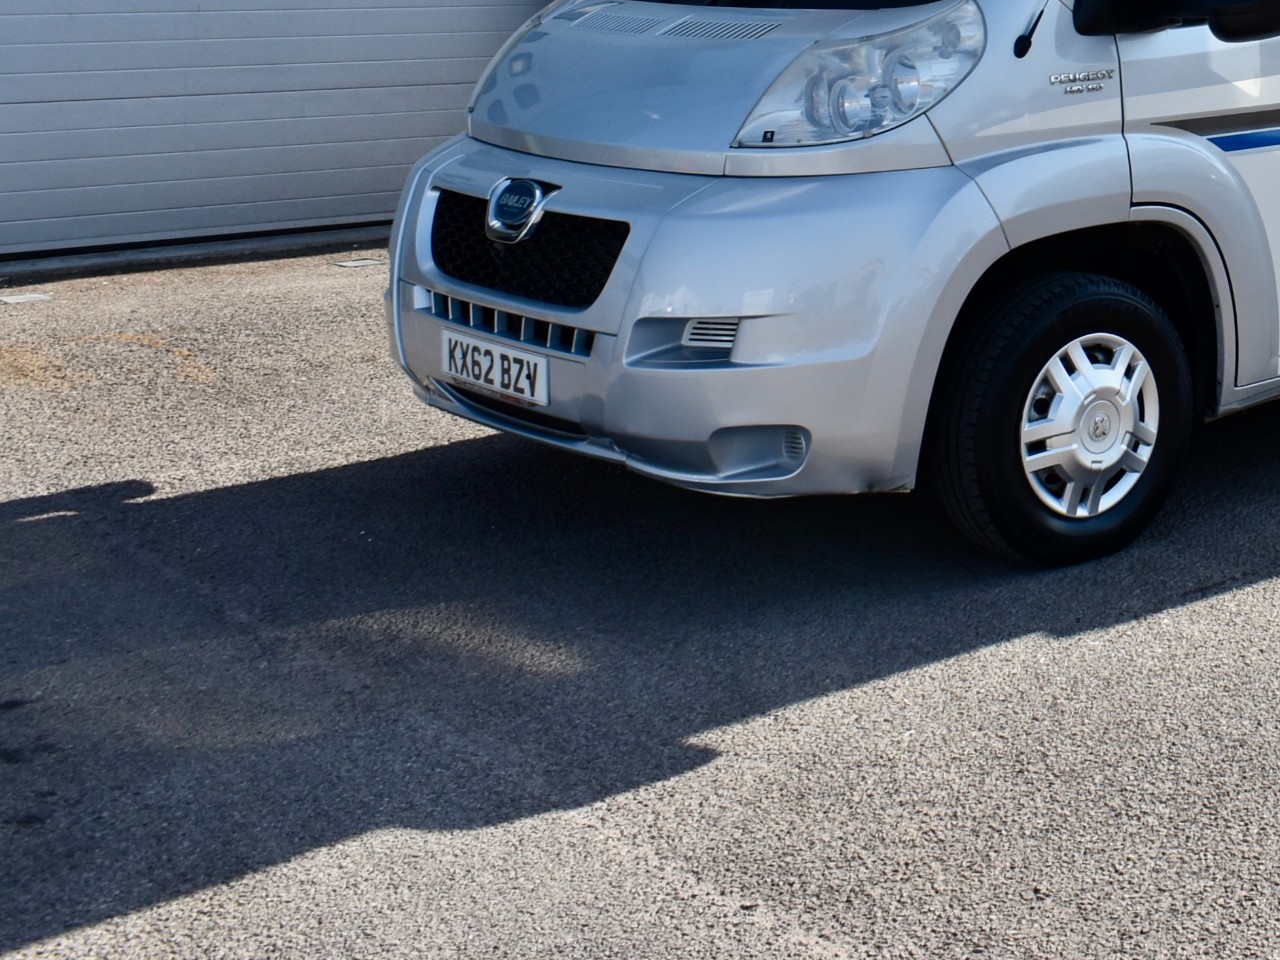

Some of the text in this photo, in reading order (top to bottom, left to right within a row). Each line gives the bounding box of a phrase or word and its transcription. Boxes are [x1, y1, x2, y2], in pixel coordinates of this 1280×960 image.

[1049, 69, 1115, 85] PEUGEOT
[499, 193, 531, 208] BAILEY
[448, 338, 495, 385] KX62
